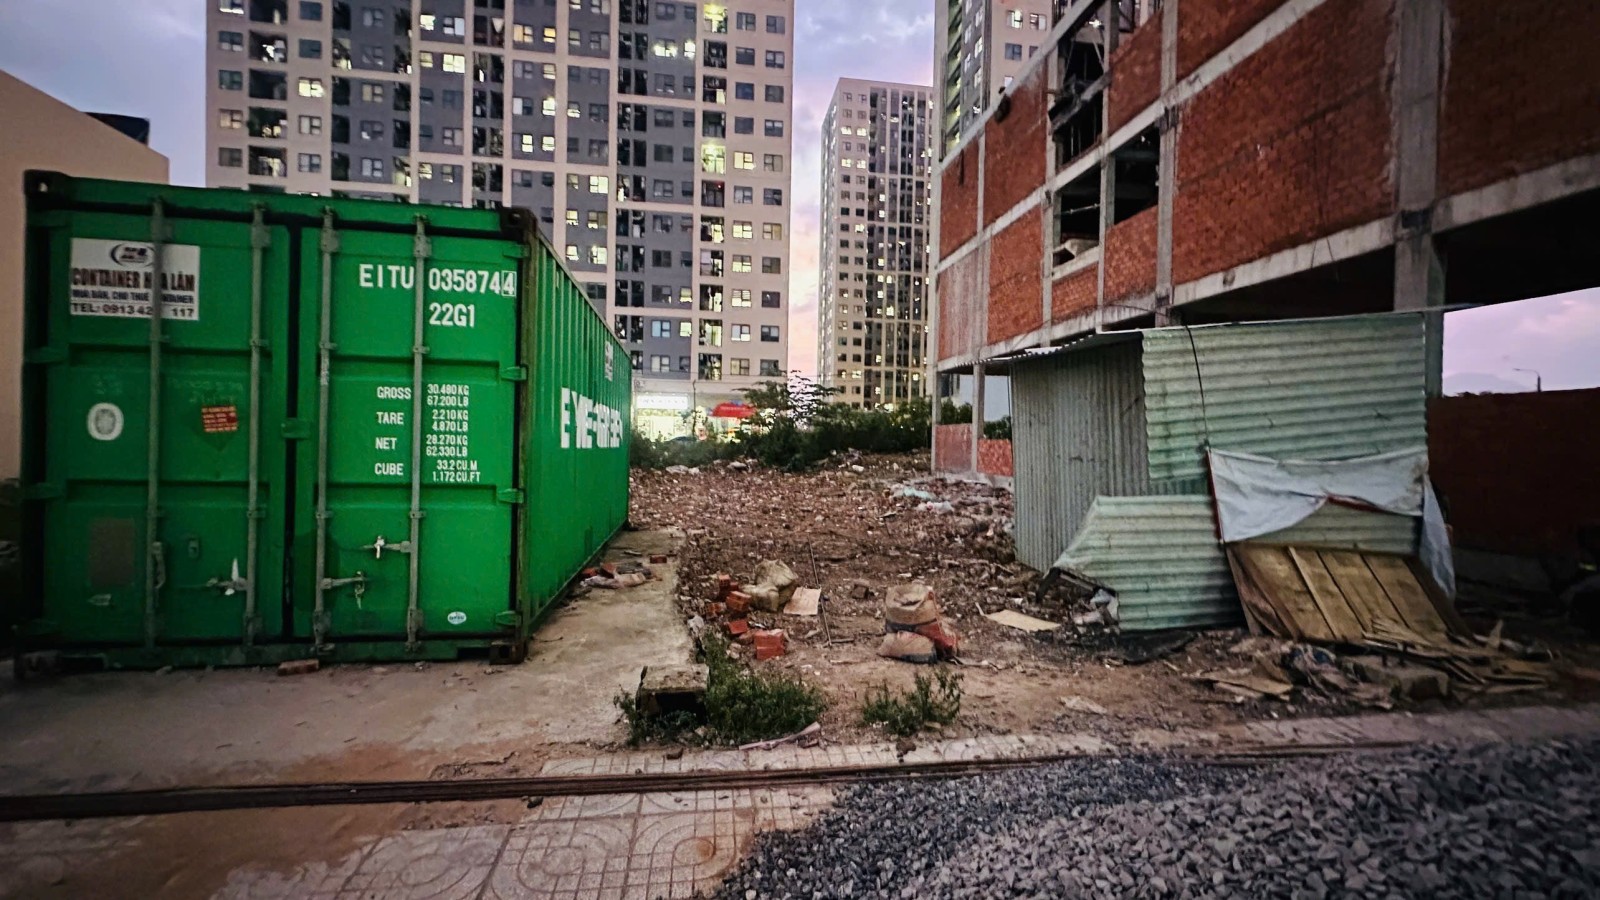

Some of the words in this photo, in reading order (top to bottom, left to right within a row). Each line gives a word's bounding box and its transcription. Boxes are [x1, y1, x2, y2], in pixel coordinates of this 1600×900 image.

[359, 264, 414, 289] EITU
[429, 302, 475, 327] 22G1
[377, 386, 412, 400] GROSS
[457, 385, 469, 396] KG
[427, 395, 457, 407] 67.200
[457, 397, 469, 407] LB
[376, 411, 405, 425] TARE
[432, 409, 456, 420] 2.210
[457, 410, 469, 420] KG
[457, 422, 469, 432] LB
[375, 437, 397, 450] NET
[456, 435, 468, 446] KG
[456, 447, 468, 457] LB
[374, 462, 404, 476] CUBE
[436, 460, 455, 470] 33.2
[432, 471, 455, 482] 1.172
